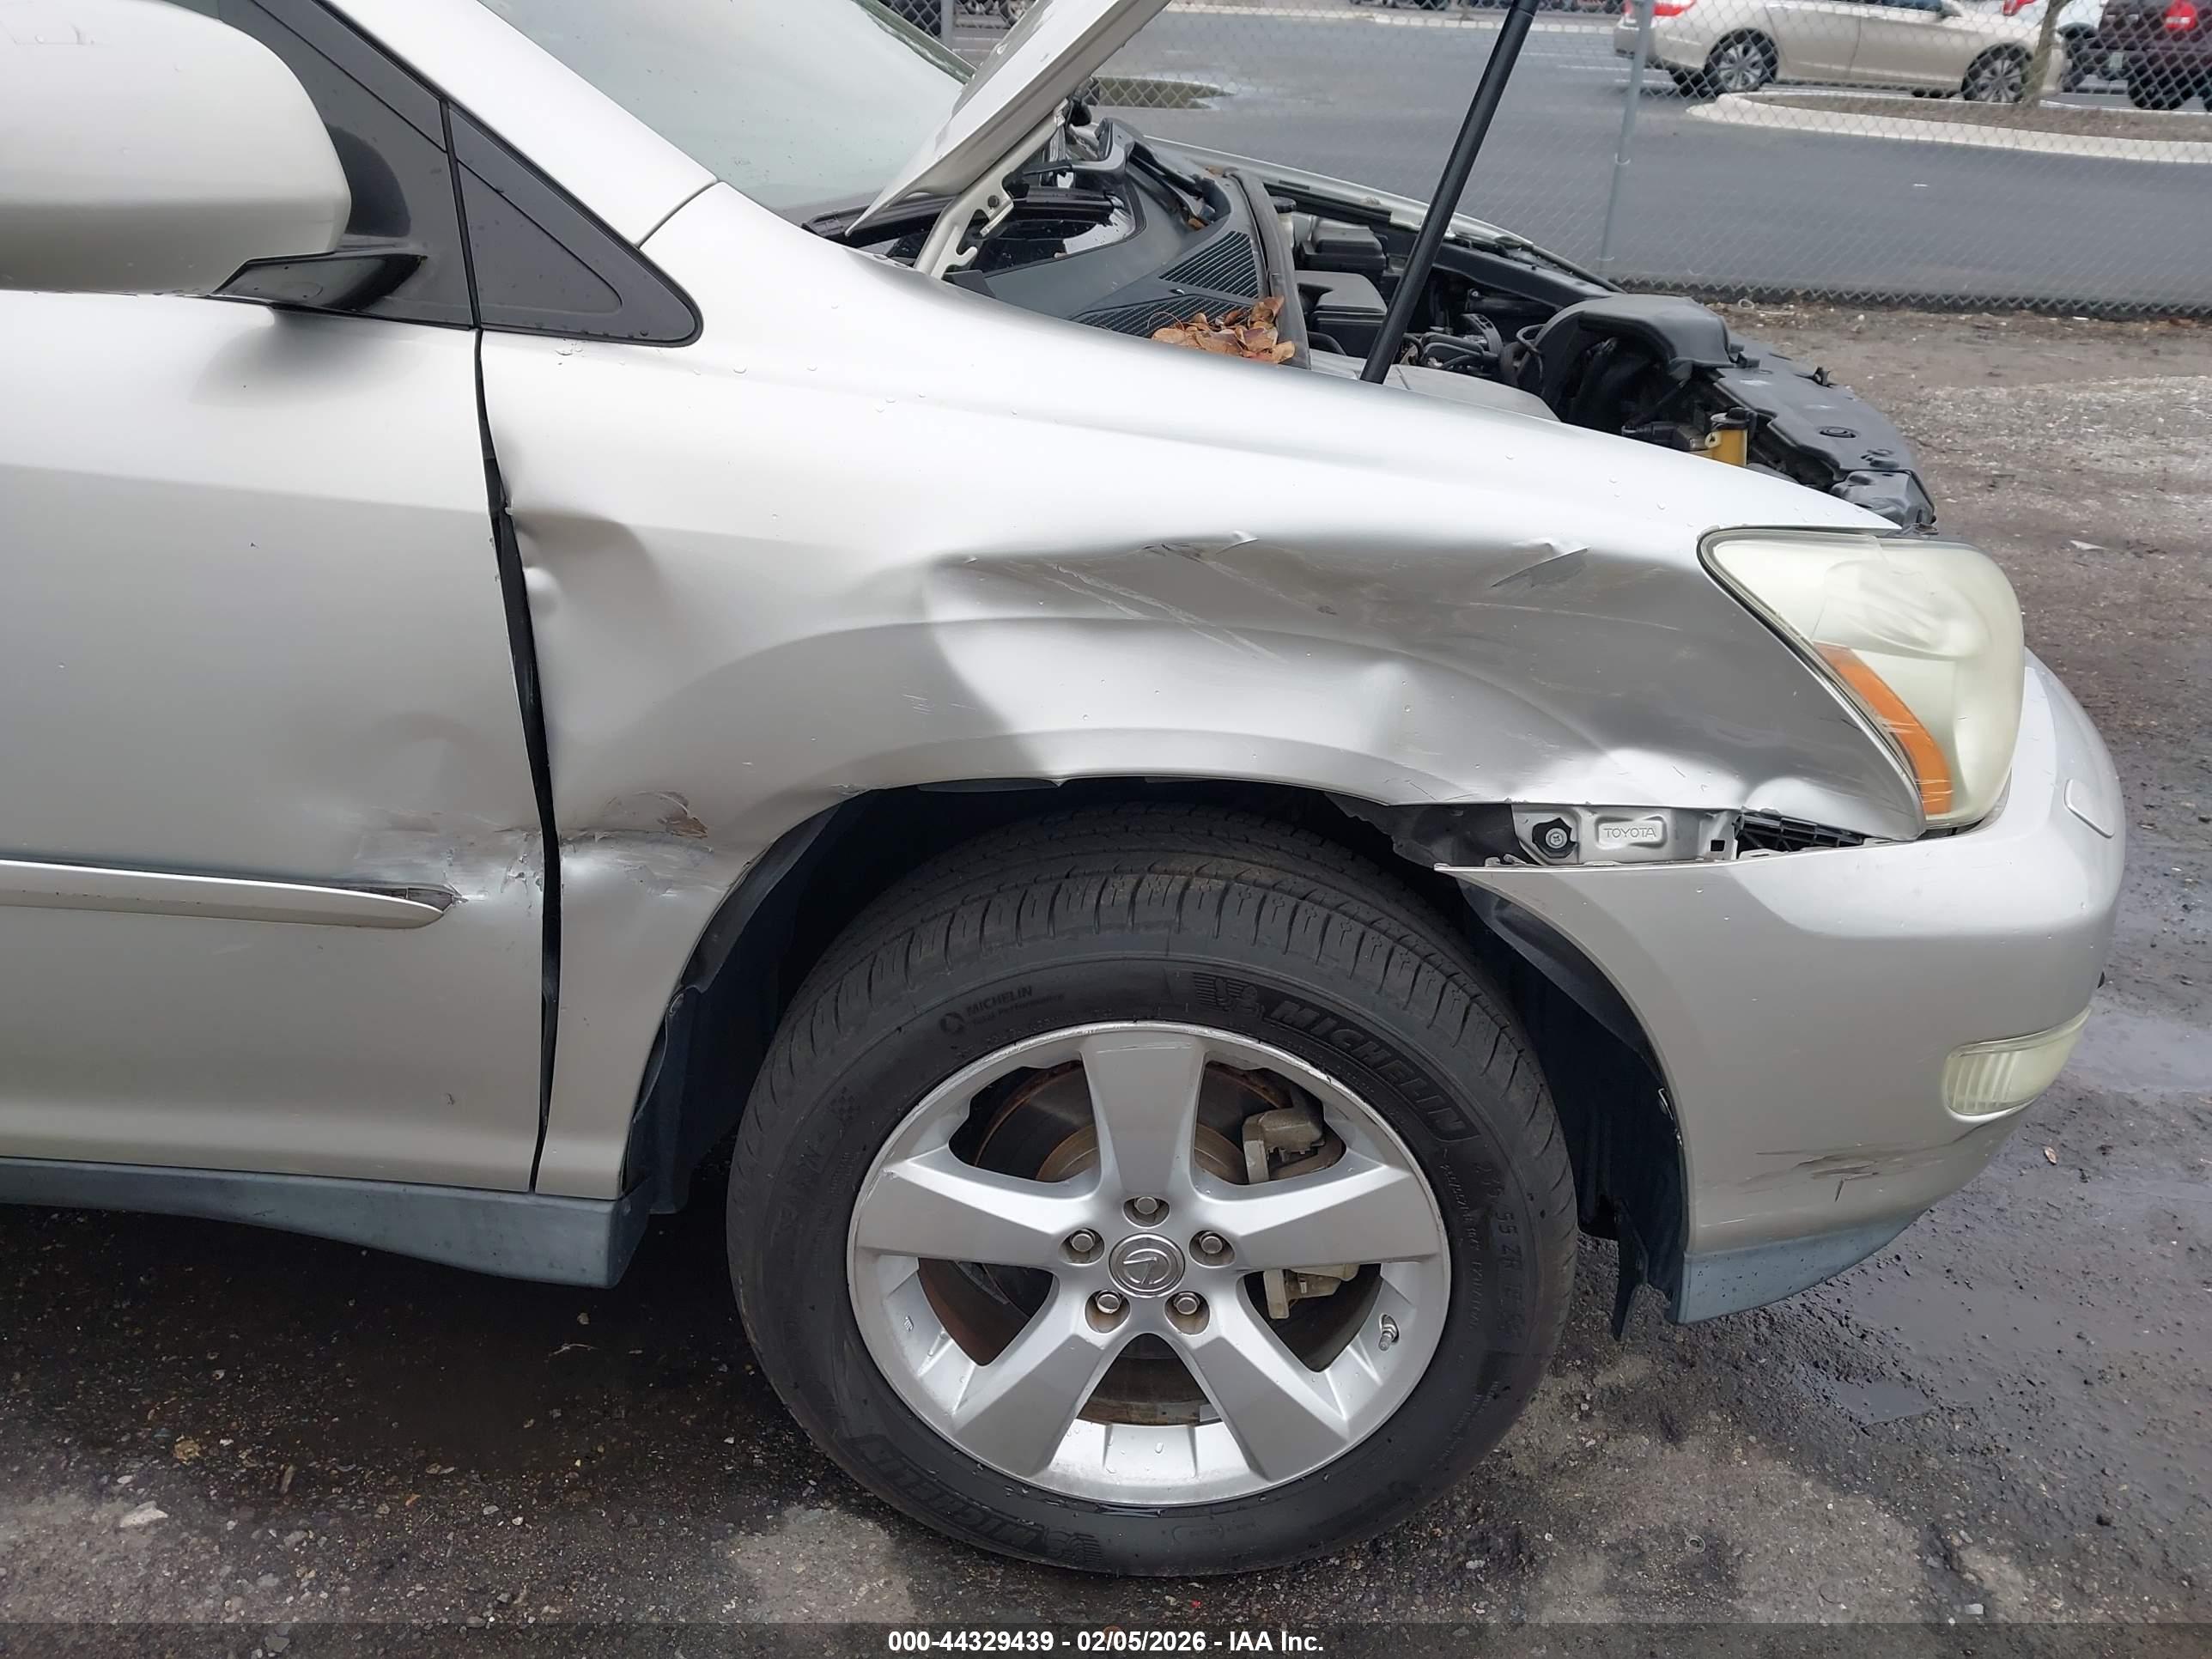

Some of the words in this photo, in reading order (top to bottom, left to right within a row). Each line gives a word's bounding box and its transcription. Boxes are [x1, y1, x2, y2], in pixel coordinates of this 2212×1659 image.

[1602, 827, 1656, 839] TOYOTA
[965, 985, 1032, 1017] MICHELIN
[1270, 1000, 1467, 1133] MICHELIN
